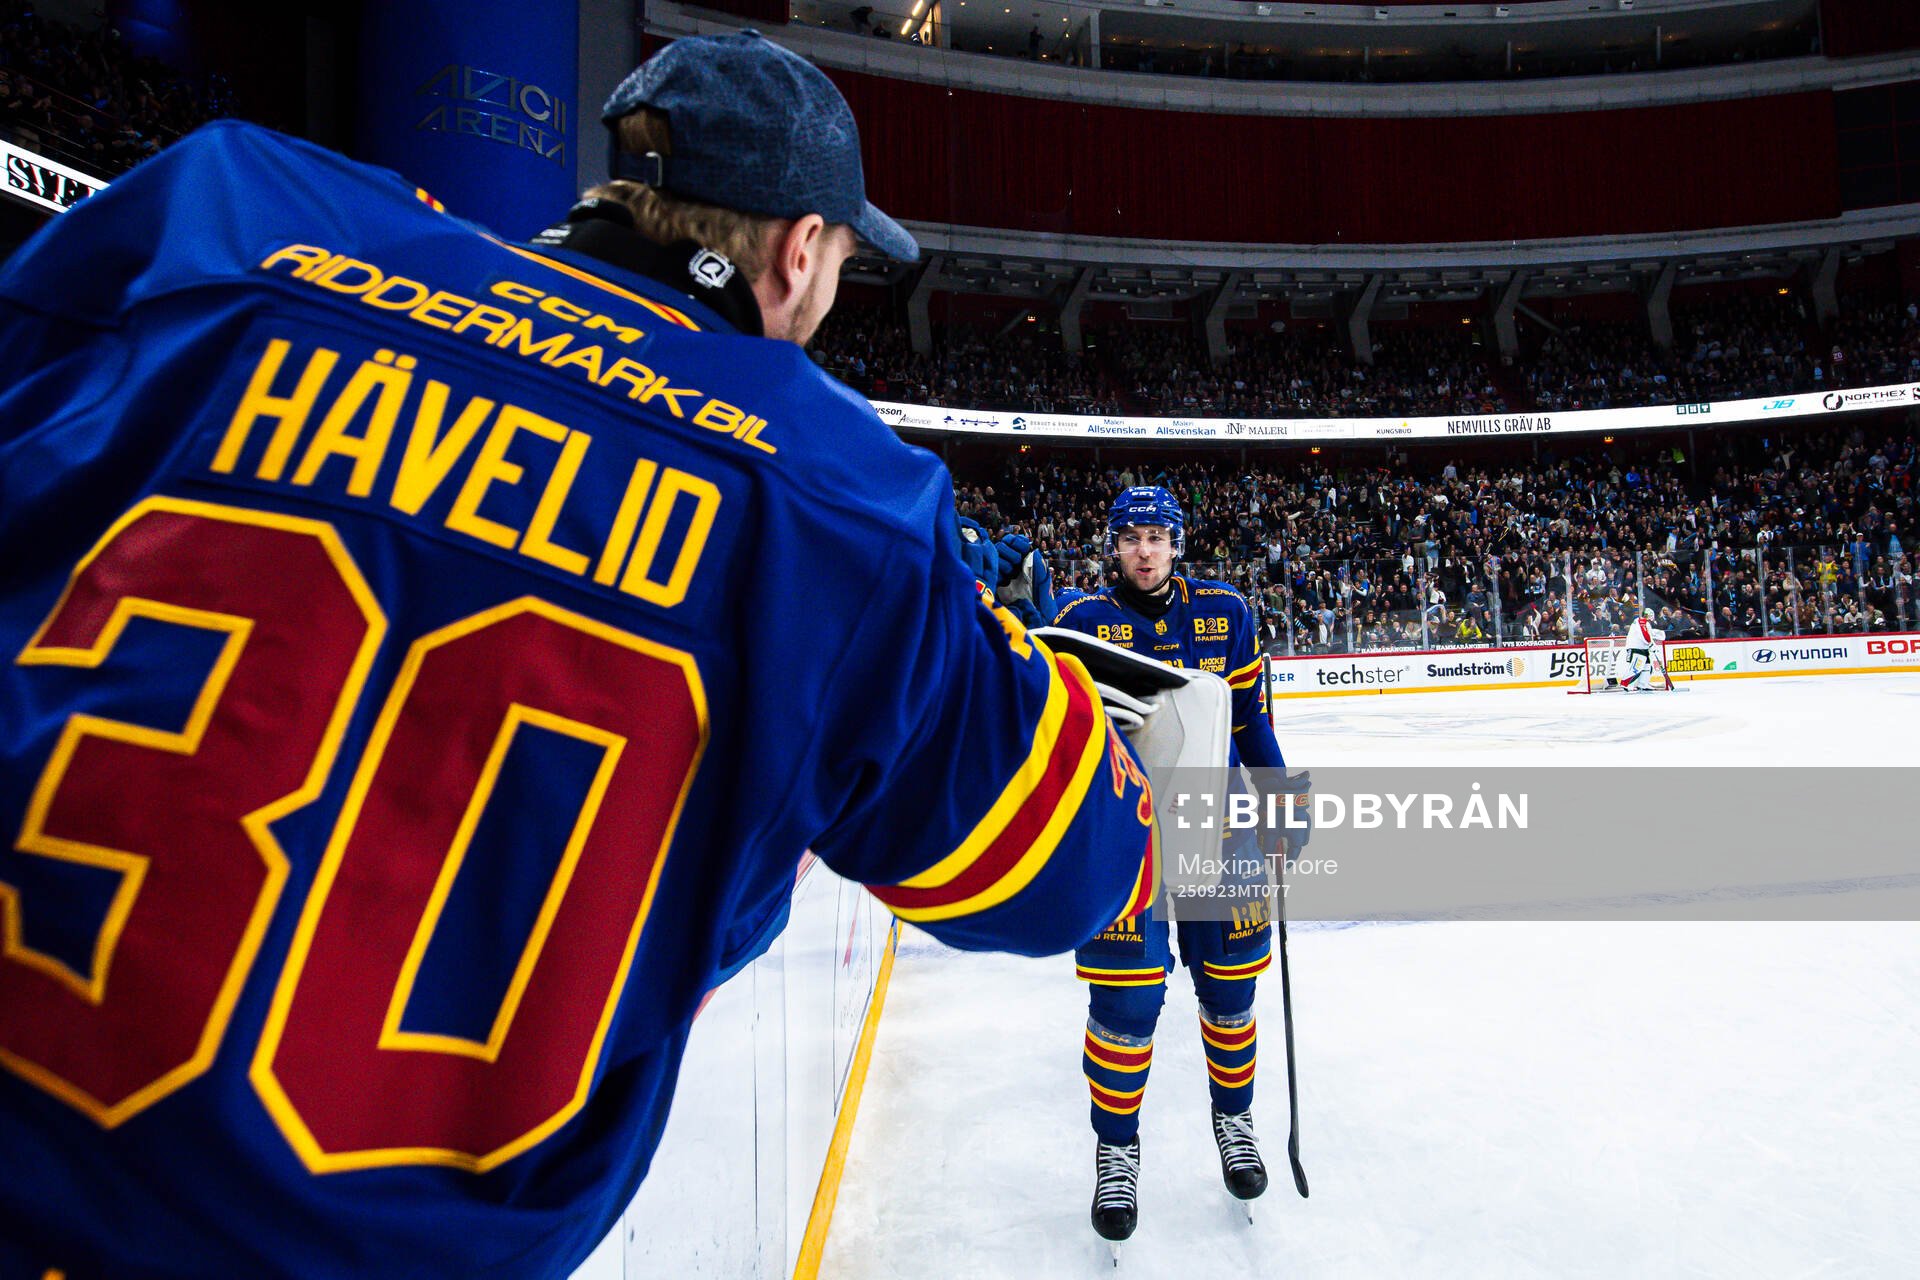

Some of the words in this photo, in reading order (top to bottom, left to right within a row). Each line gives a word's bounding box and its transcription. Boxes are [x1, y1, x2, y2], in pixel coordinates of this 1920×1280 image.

[416, 104, 566, 169] ARENA
[490, 281, 646, 344] CCM
[260, 242, 703, 418] RIDDERMARK
[692, 397, 778, 455] BIL
[1845, 389, 1907, 401] NORTHEX
[1087, 425, 1147, 435] Allsvenskan
[1156, 426, 1216, 436] Allsvenskan
[1447, 419, 1501, 434] NEMVILLS
[1504, 416, 1534, 432] GRÄV
[1536, 417, 1552, 431] AB
[210, 338, 722, 608] HÄVELID
[1128, 505, 1157, 513] CCM
[1097, 624, 1134, 641] B2B
[1193, 617, 1230, 635] B2B
[1153, 643, 1180, 651] CCM
[1673, 647, 1700, 660] EURO
[1780, 647, 1848, 661] HYUNDAI
[1426, 661, 1505, 678] Sundström
[1667, 658, 1711, 672] JACKPOT
[1317, 664, 1403, 686] techster
[0, 494, 710, 1175] 30
[1103, 933, 1143, 943] RENTAL
[1228, 928, 1254, 941] ROAD
[1216, 1017, 1245, 1026] CCM
[1101, 1029, 1130, 1044] CCM
